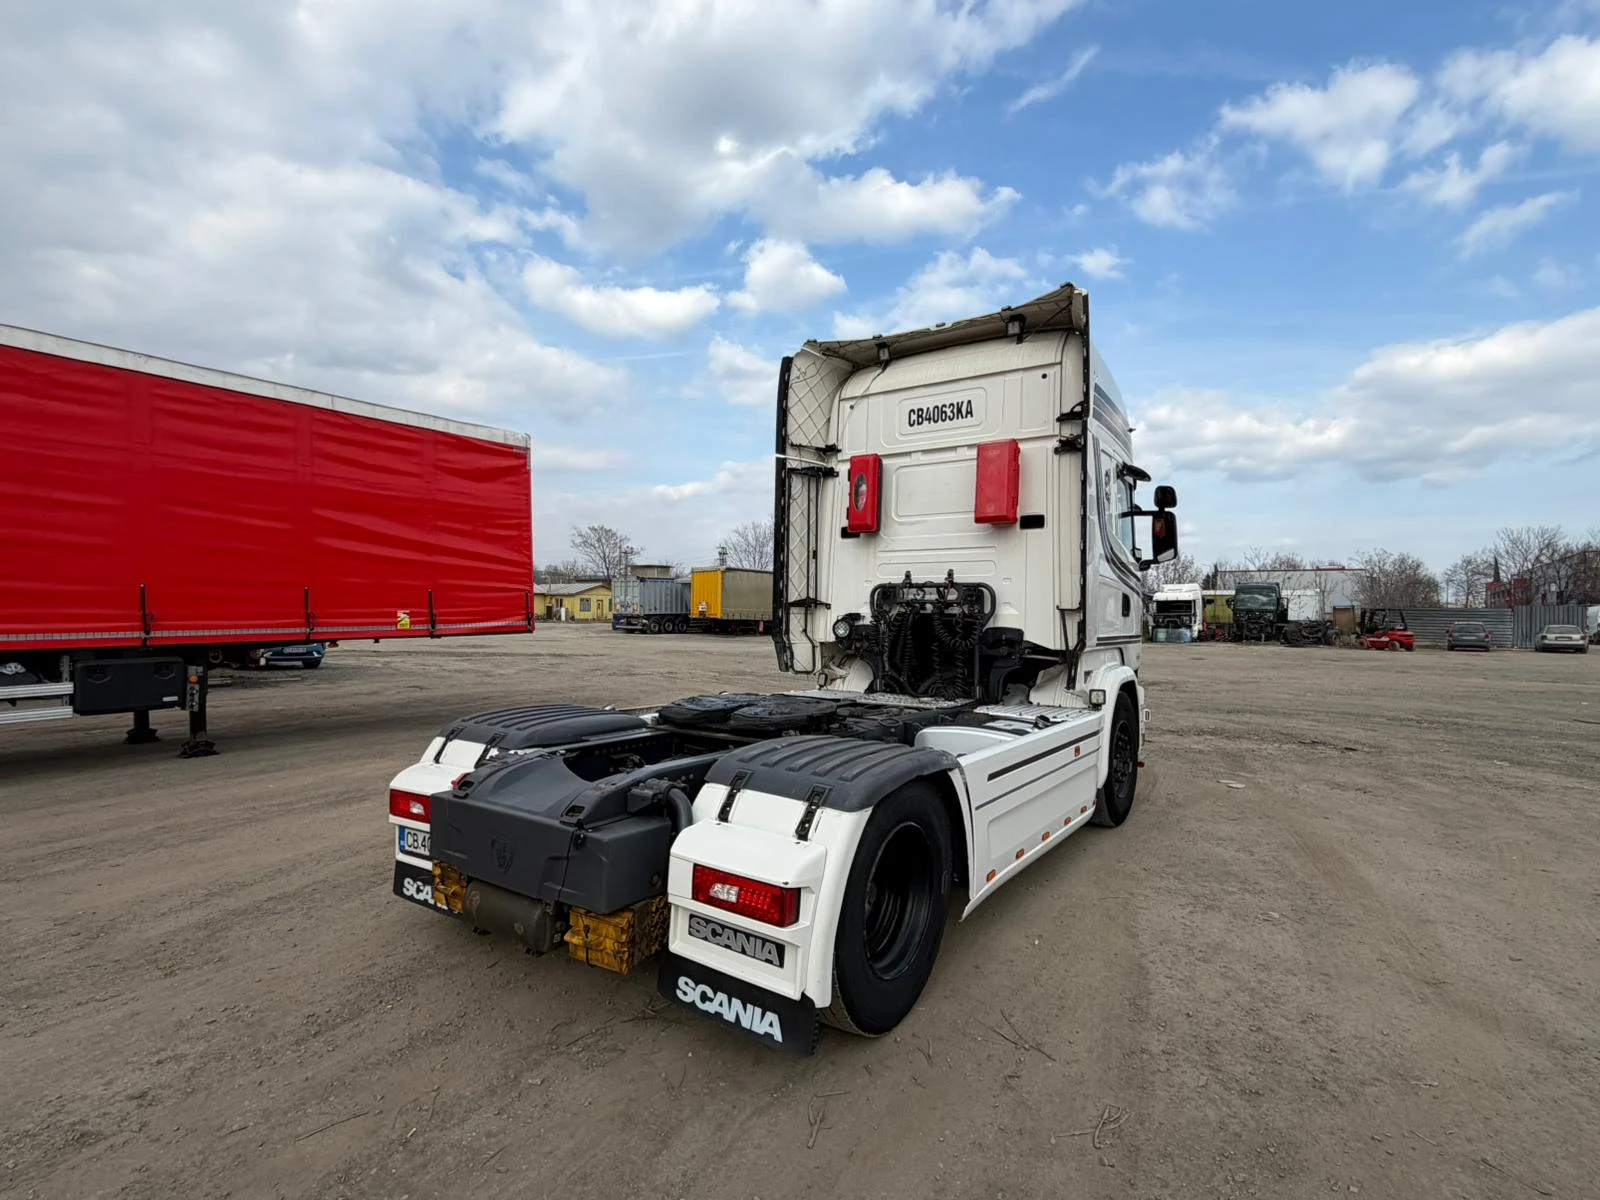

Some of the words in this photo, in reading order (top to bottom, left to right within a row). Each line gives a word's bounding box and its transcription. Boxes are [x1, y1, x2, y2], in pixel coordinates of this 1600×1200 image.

[908, 399, 974, 428] CB4063KA
[690, 917, 781, 967] SCANIA
[676, 976, 784, 1043] SCANIA
